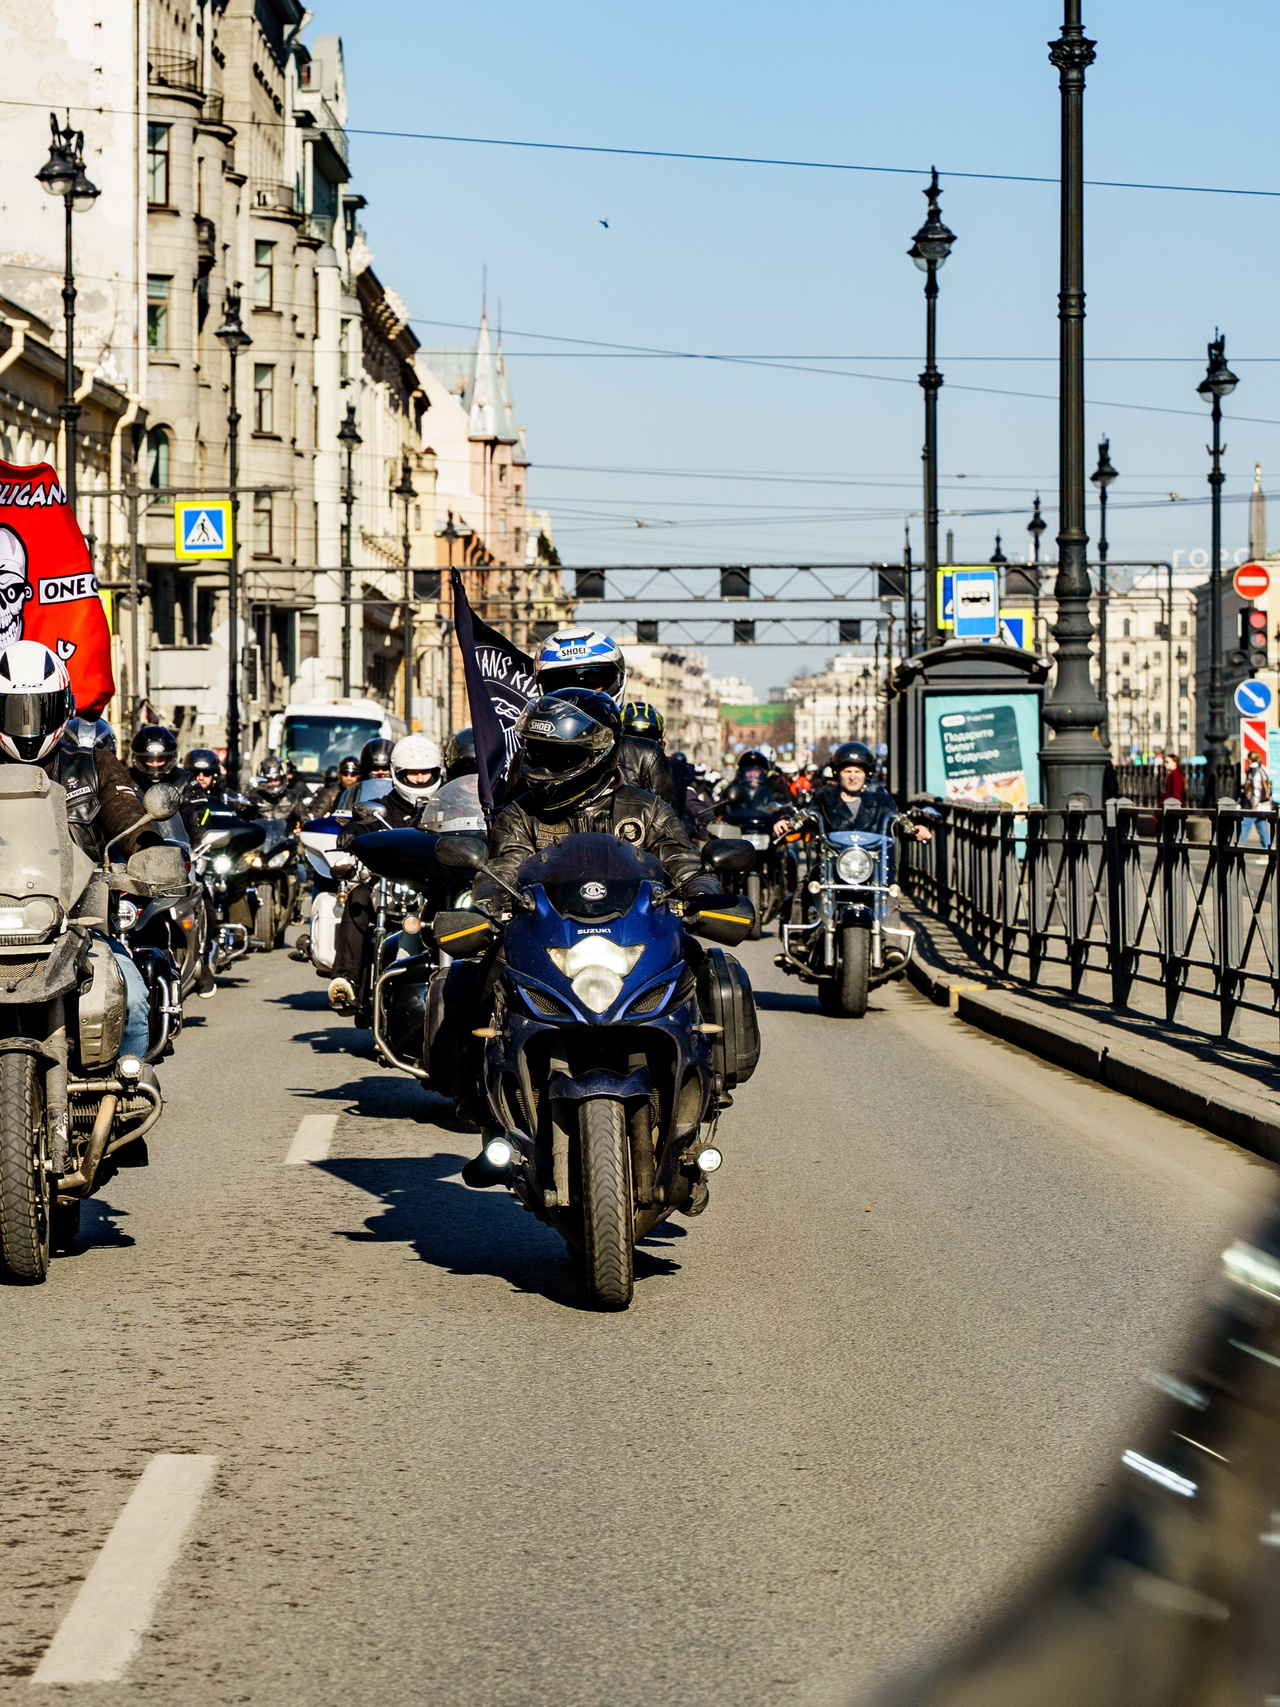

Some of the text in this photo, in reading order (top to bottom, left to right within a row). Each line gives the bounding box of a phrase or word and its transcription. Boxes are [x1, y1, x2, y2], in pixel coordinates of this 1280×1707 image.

[44, 577, 86, 600] ONE
[560, 647, 587, 658] SHOEI
[475, 649, 541, 699] ANS KIL
[530, 721, 552, 732] SHOEI
[943, 729, 995, 743] Подарите
[945, 742, 976, 754] билет
[946, 749, 1000, 764] в будущее
